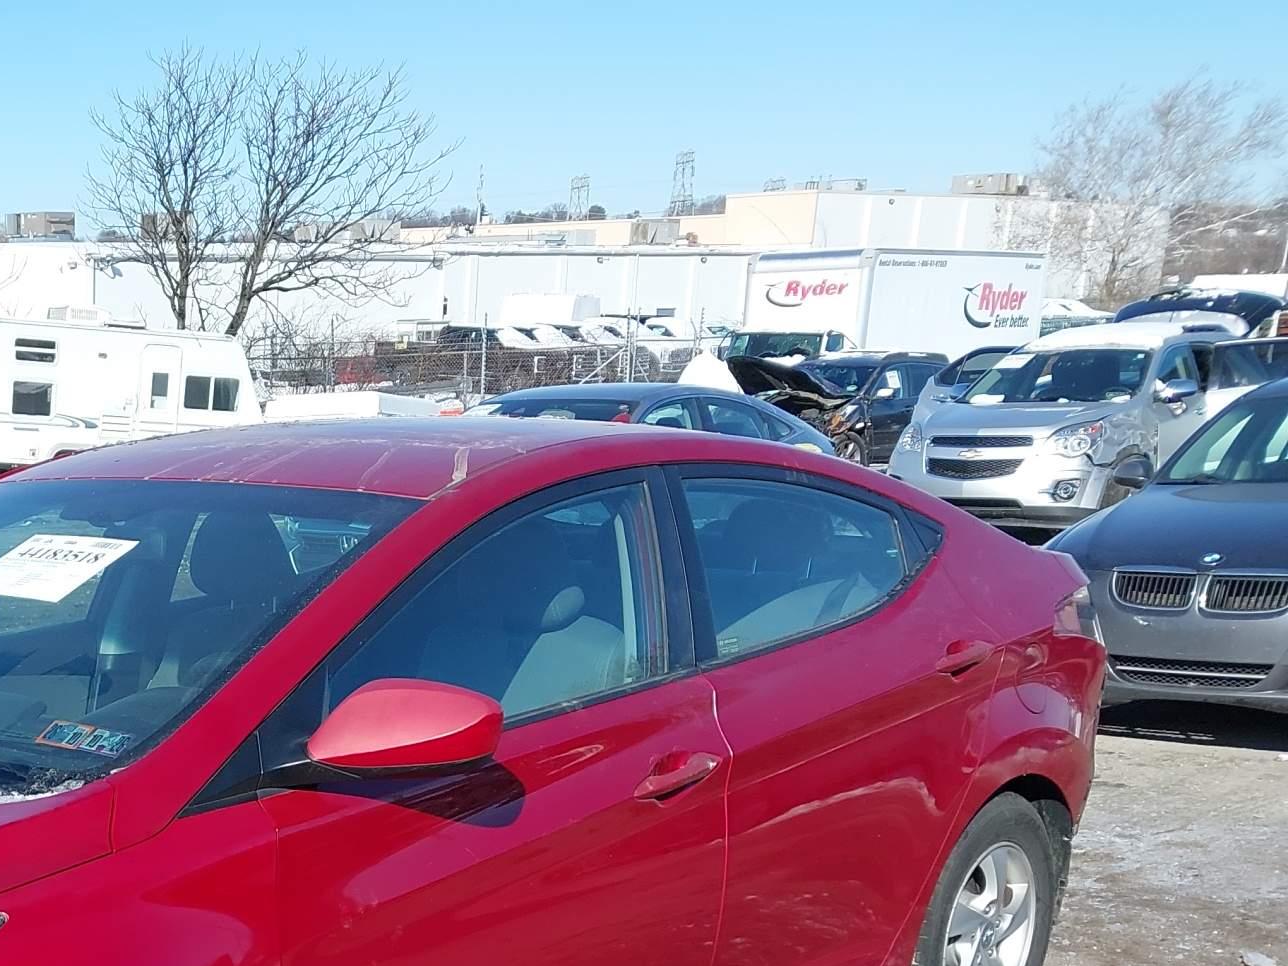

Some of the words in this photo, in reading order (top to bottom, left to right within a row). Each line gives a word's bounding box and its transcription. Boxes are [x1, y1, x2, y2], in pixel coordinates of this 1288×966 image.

[784, 279, 848, 300] Ryder
[978, 283, 1027, 317] Ryder
[994, 314, 1009, 328] Ever
[18, 546, 106, 564] 44183518
